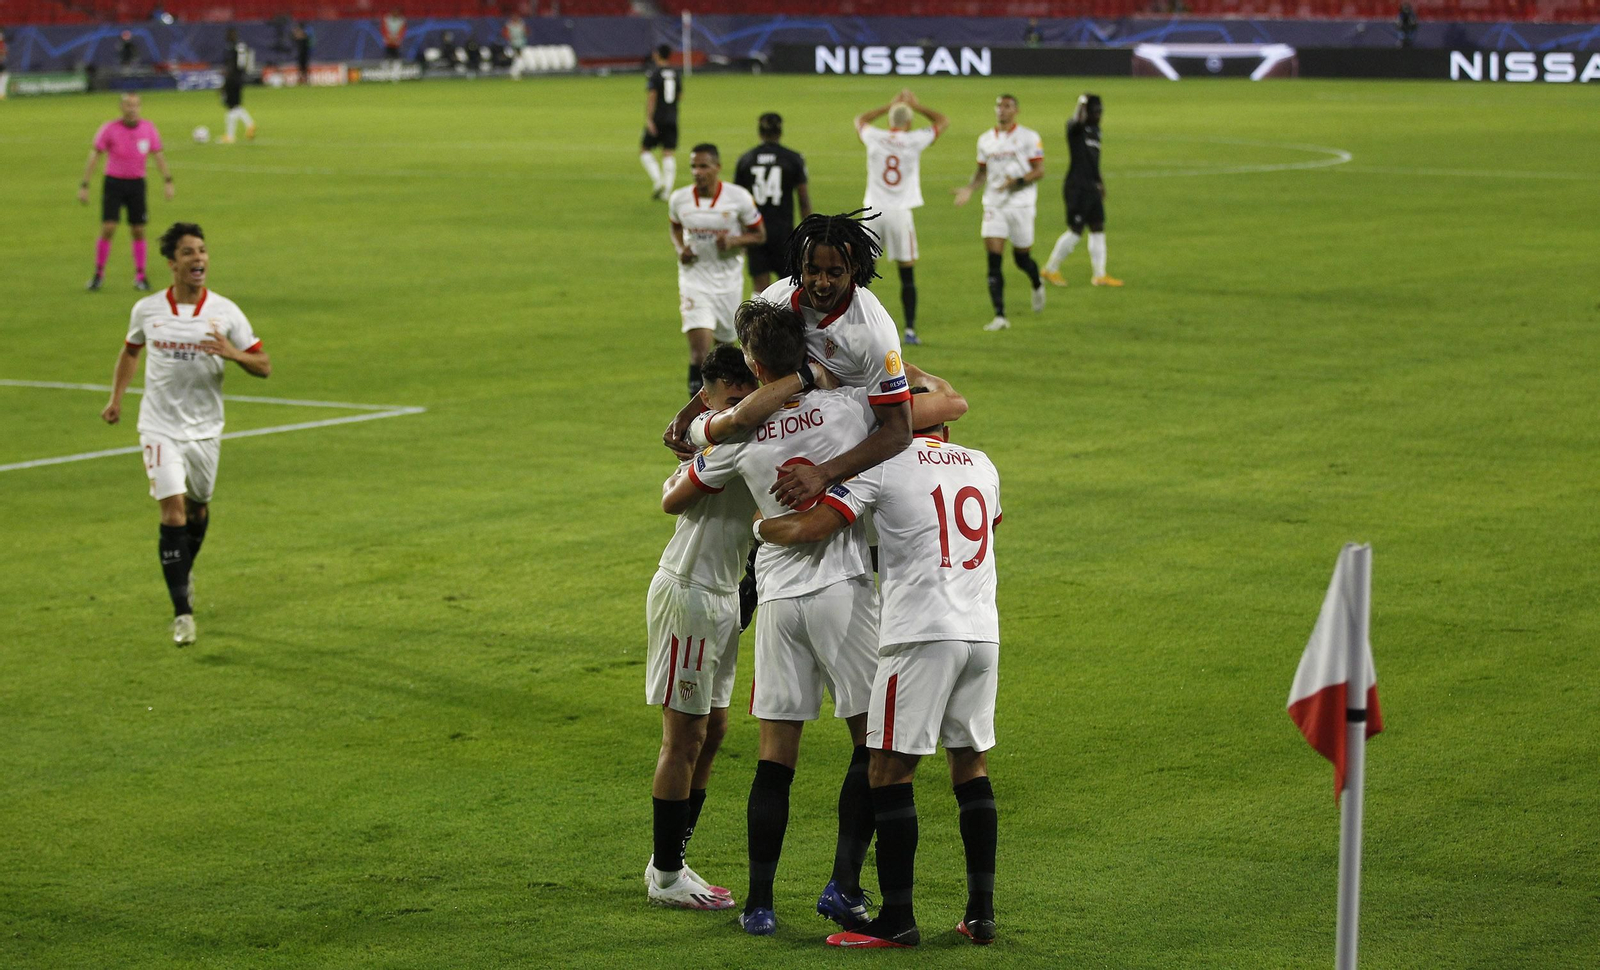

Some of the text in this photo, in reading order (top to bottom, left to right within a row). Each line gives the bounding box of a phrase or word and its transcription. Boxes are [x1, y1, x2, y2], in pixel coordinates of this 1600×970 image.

[814, 45, 992, 76] NISSAN
[750, 165, 782, 206] 34
[882, 155, 902, 186] 8
[173, 351, 196, 361] BET
[756, 408, 824, 442] DE JONG
[917, 449, 974, 466] ACUÑA
[930, 484, 988, 570] 19
[682, 634, 706, 672] 11
